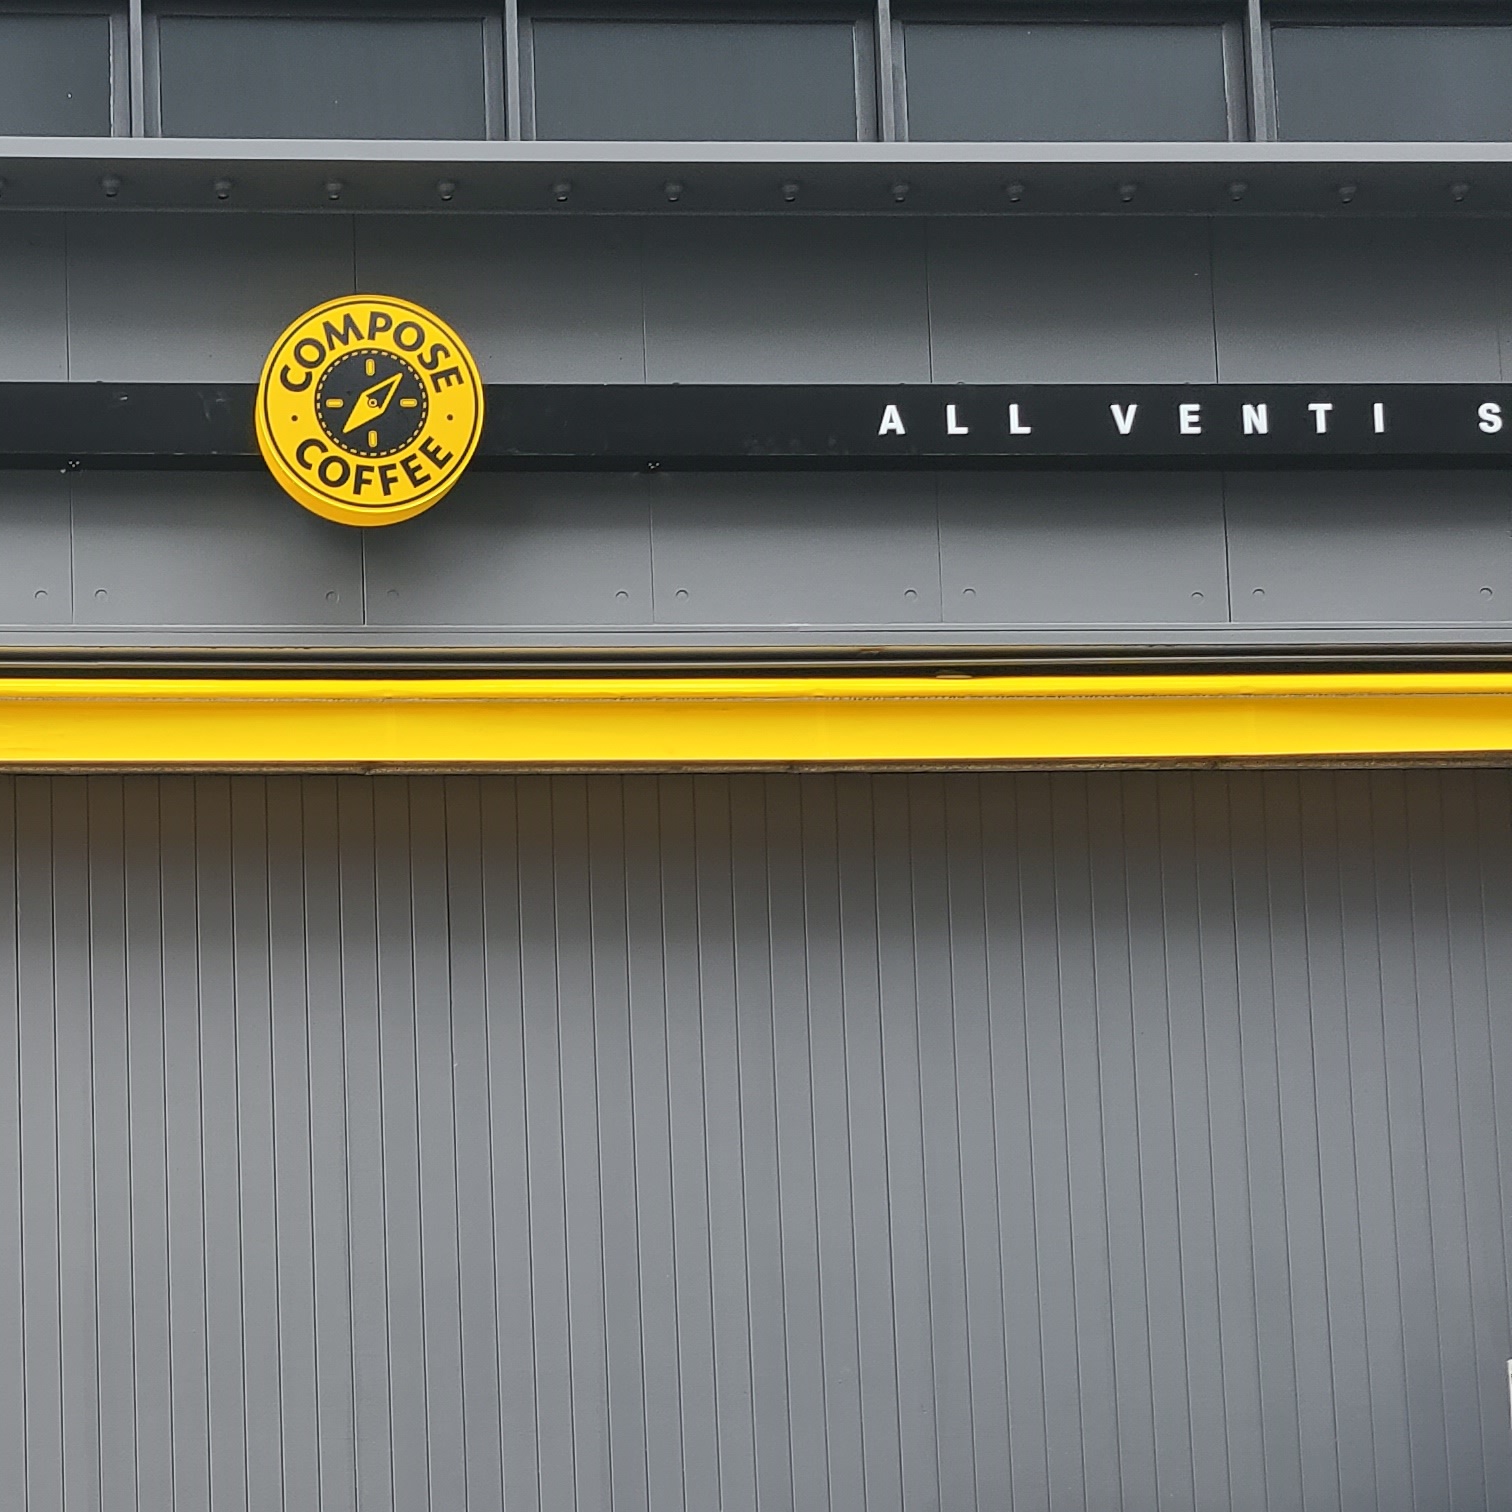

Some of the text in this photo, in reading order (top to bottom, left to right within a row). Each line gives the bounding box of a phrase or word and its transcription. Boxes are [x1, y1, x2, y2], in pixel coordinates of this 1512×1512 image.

[279, 310, 465, 394] COMPOSE
[878, 402, 1503, 436] ALL VENTI S
[295, 436, 454, 497] COFFEE
